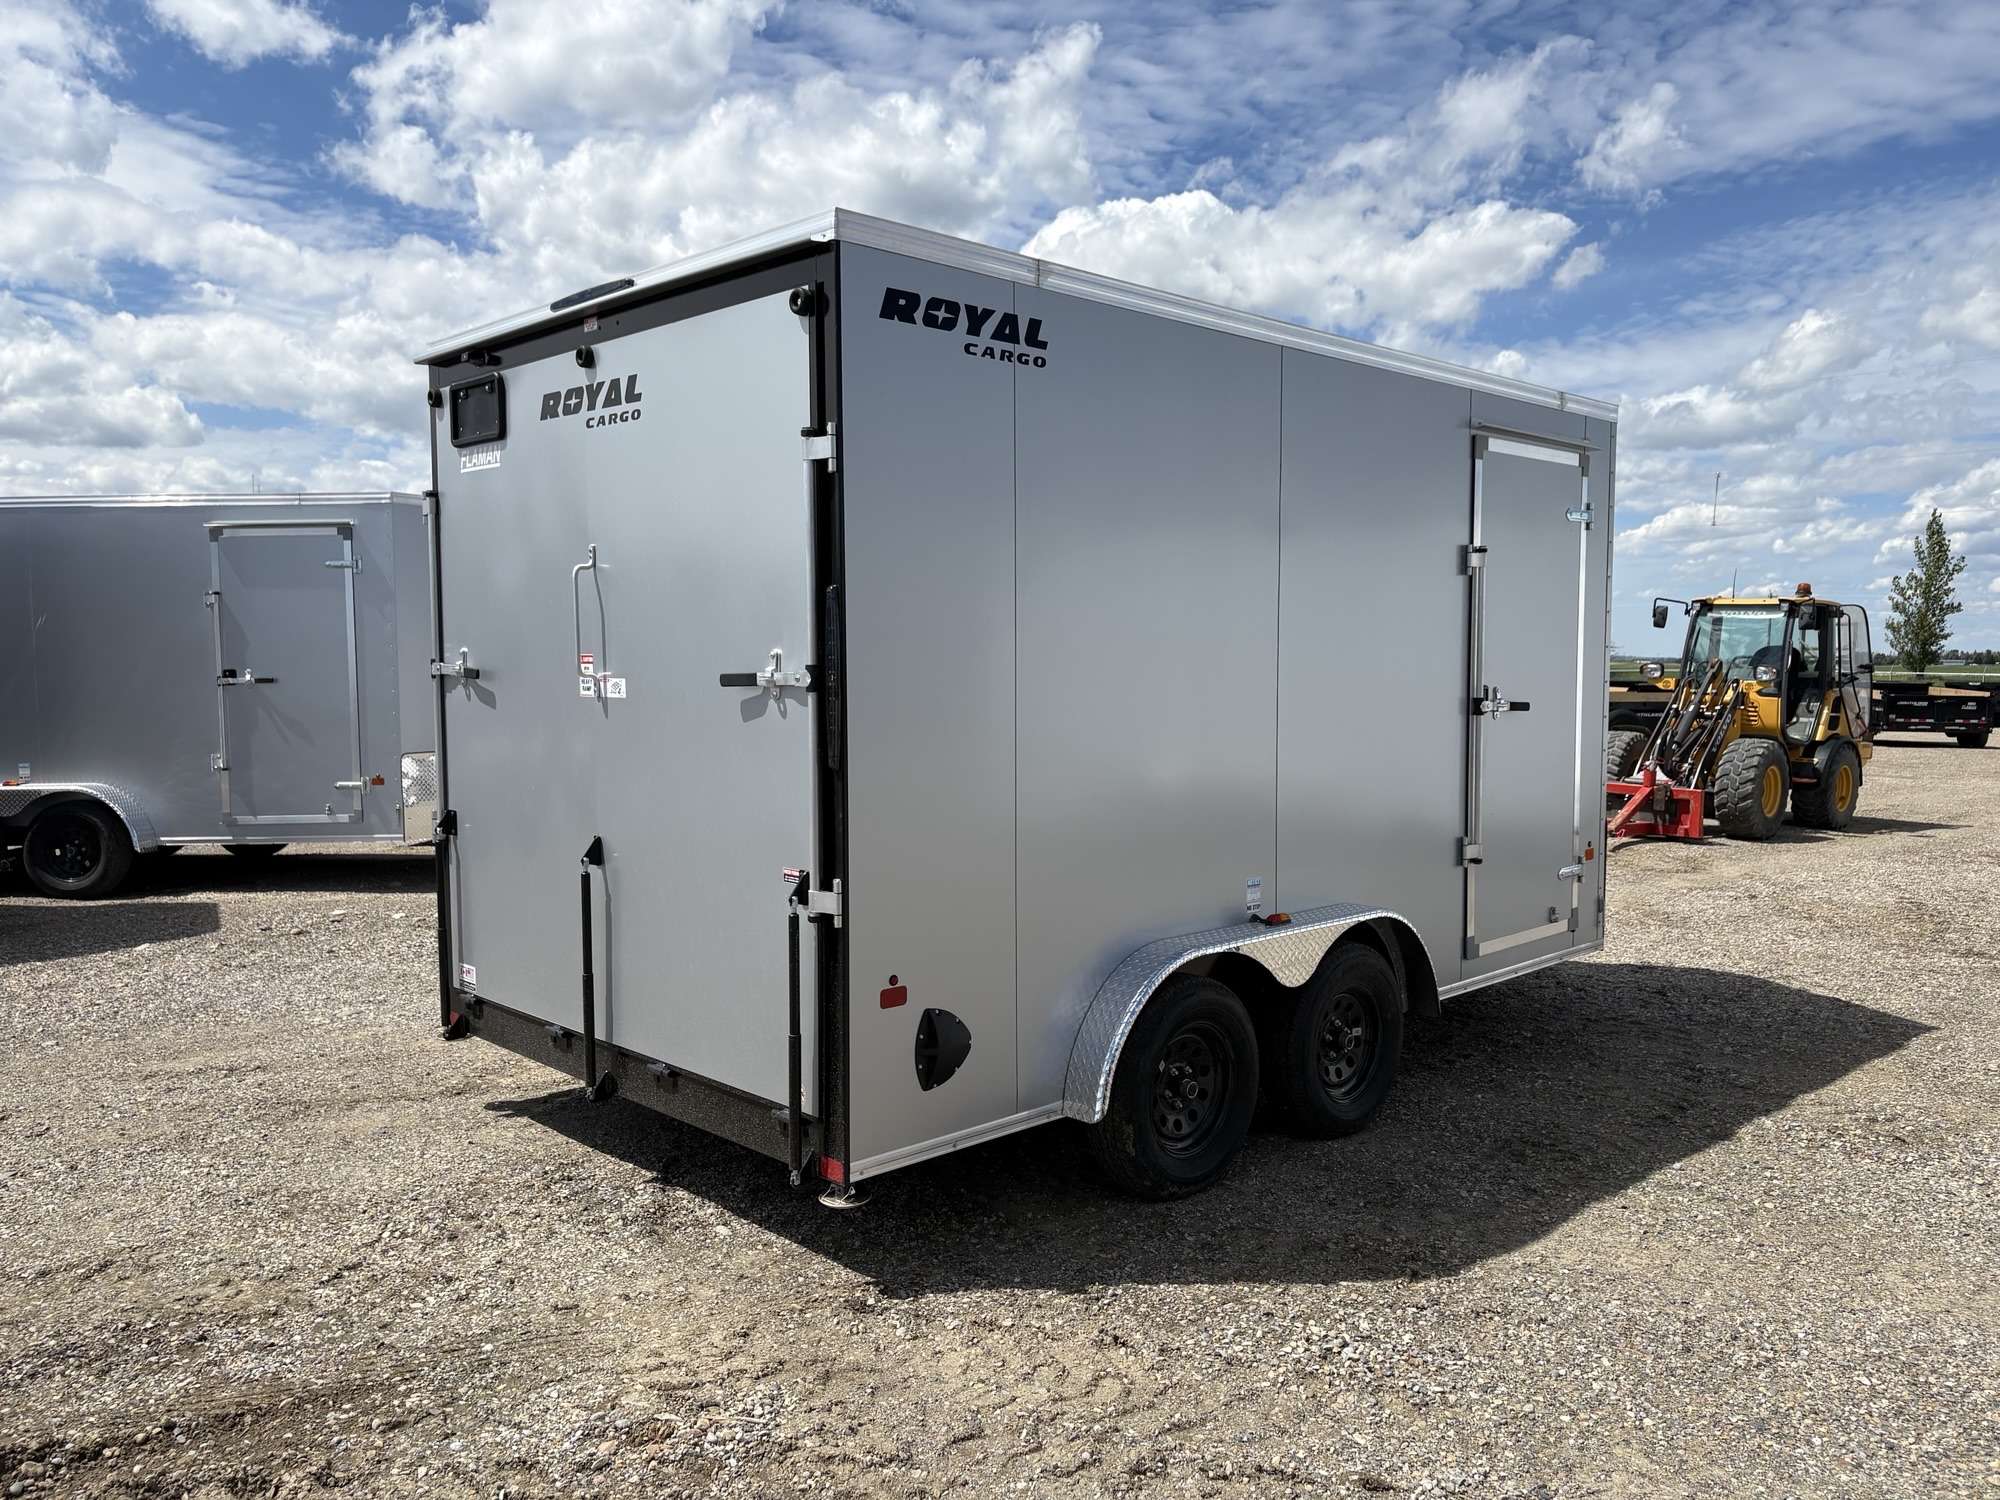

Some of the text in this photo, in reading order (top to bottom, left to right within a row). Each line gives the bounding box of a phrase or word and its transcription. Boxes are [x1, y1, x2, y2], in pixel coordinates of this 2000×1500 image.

[879, 287, 1048, 350] ROYAL
[963, 342, 1047, 368] CARGO
[540, 374, 642, 421] ROYAL
[585, 408, 642, 429] CARGO
[461, 446, 501, 468] FLAMAN
